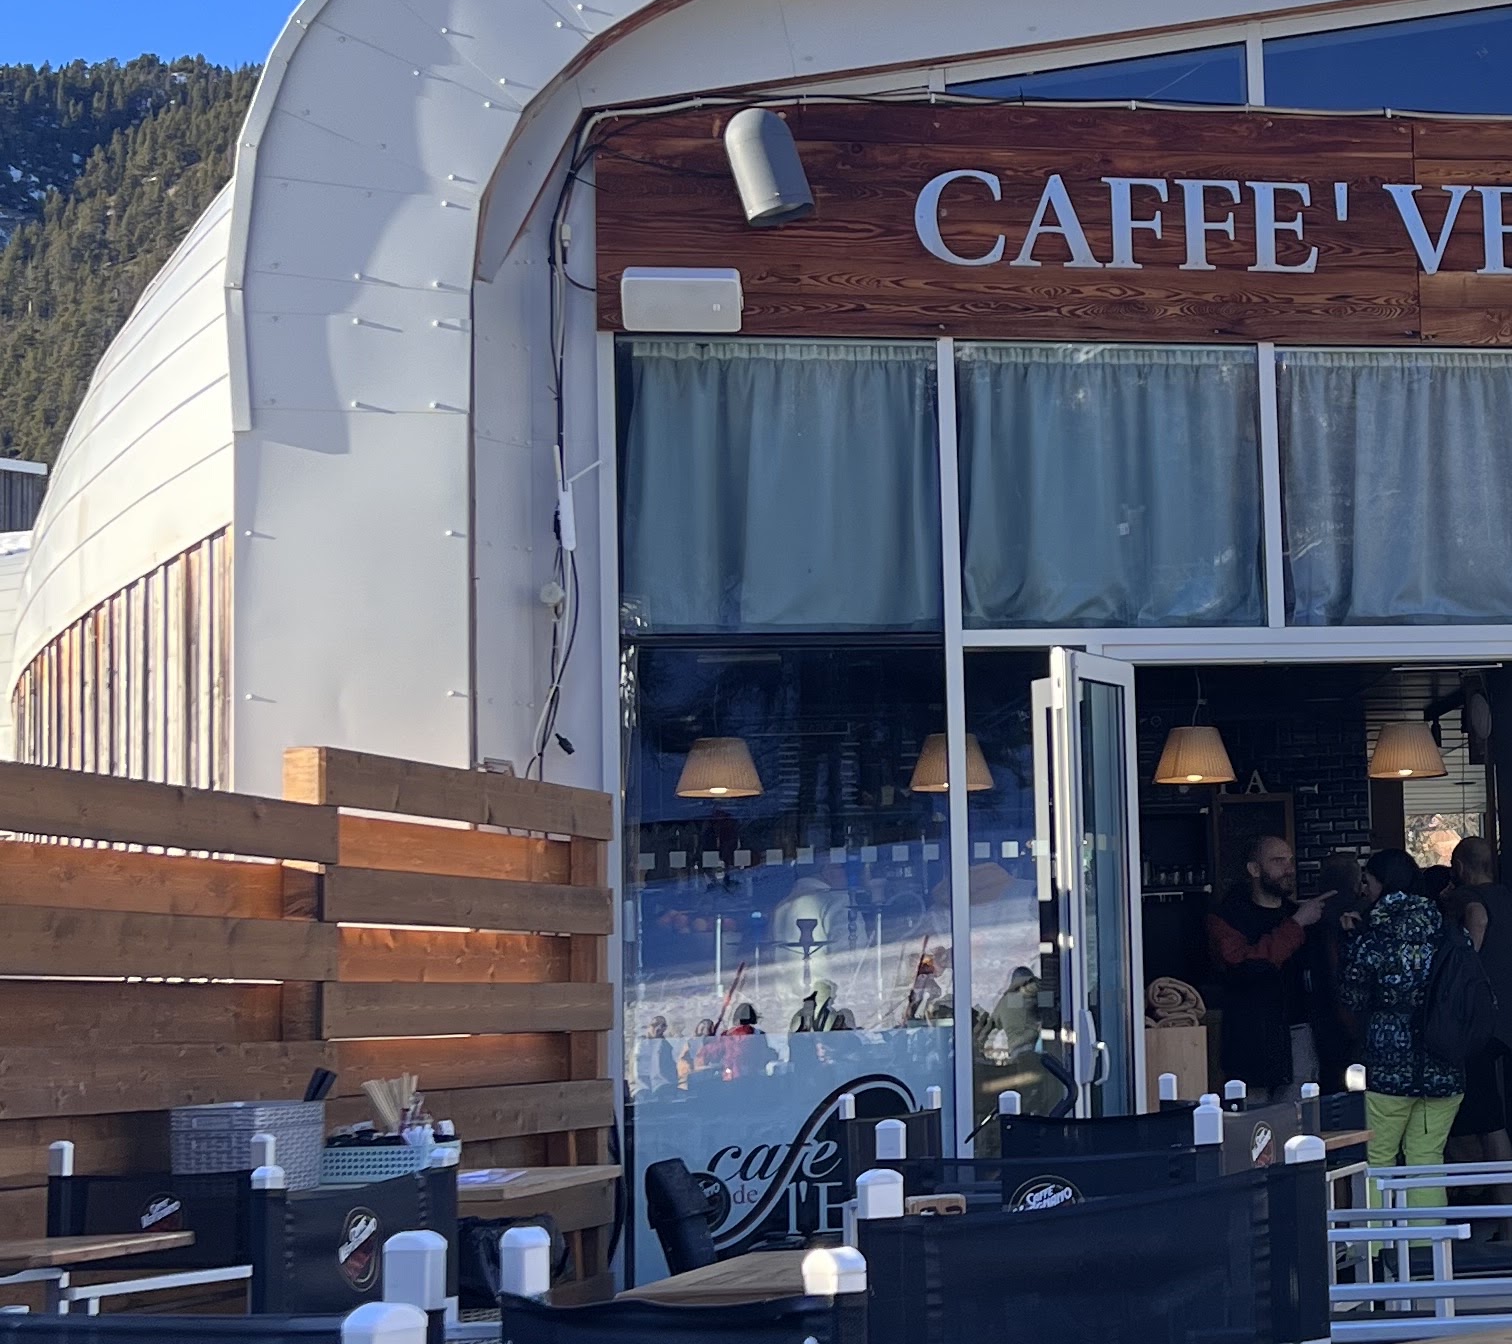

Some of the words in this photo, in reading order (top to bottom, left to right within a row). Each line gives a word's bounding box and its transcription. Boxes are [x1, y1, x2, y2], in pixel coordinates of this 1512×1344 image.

[914, 169, 1349, 273] CAFFE'
[733, 1184, 758, 1204] de
[786, 1181, 844, 1235] l'E
